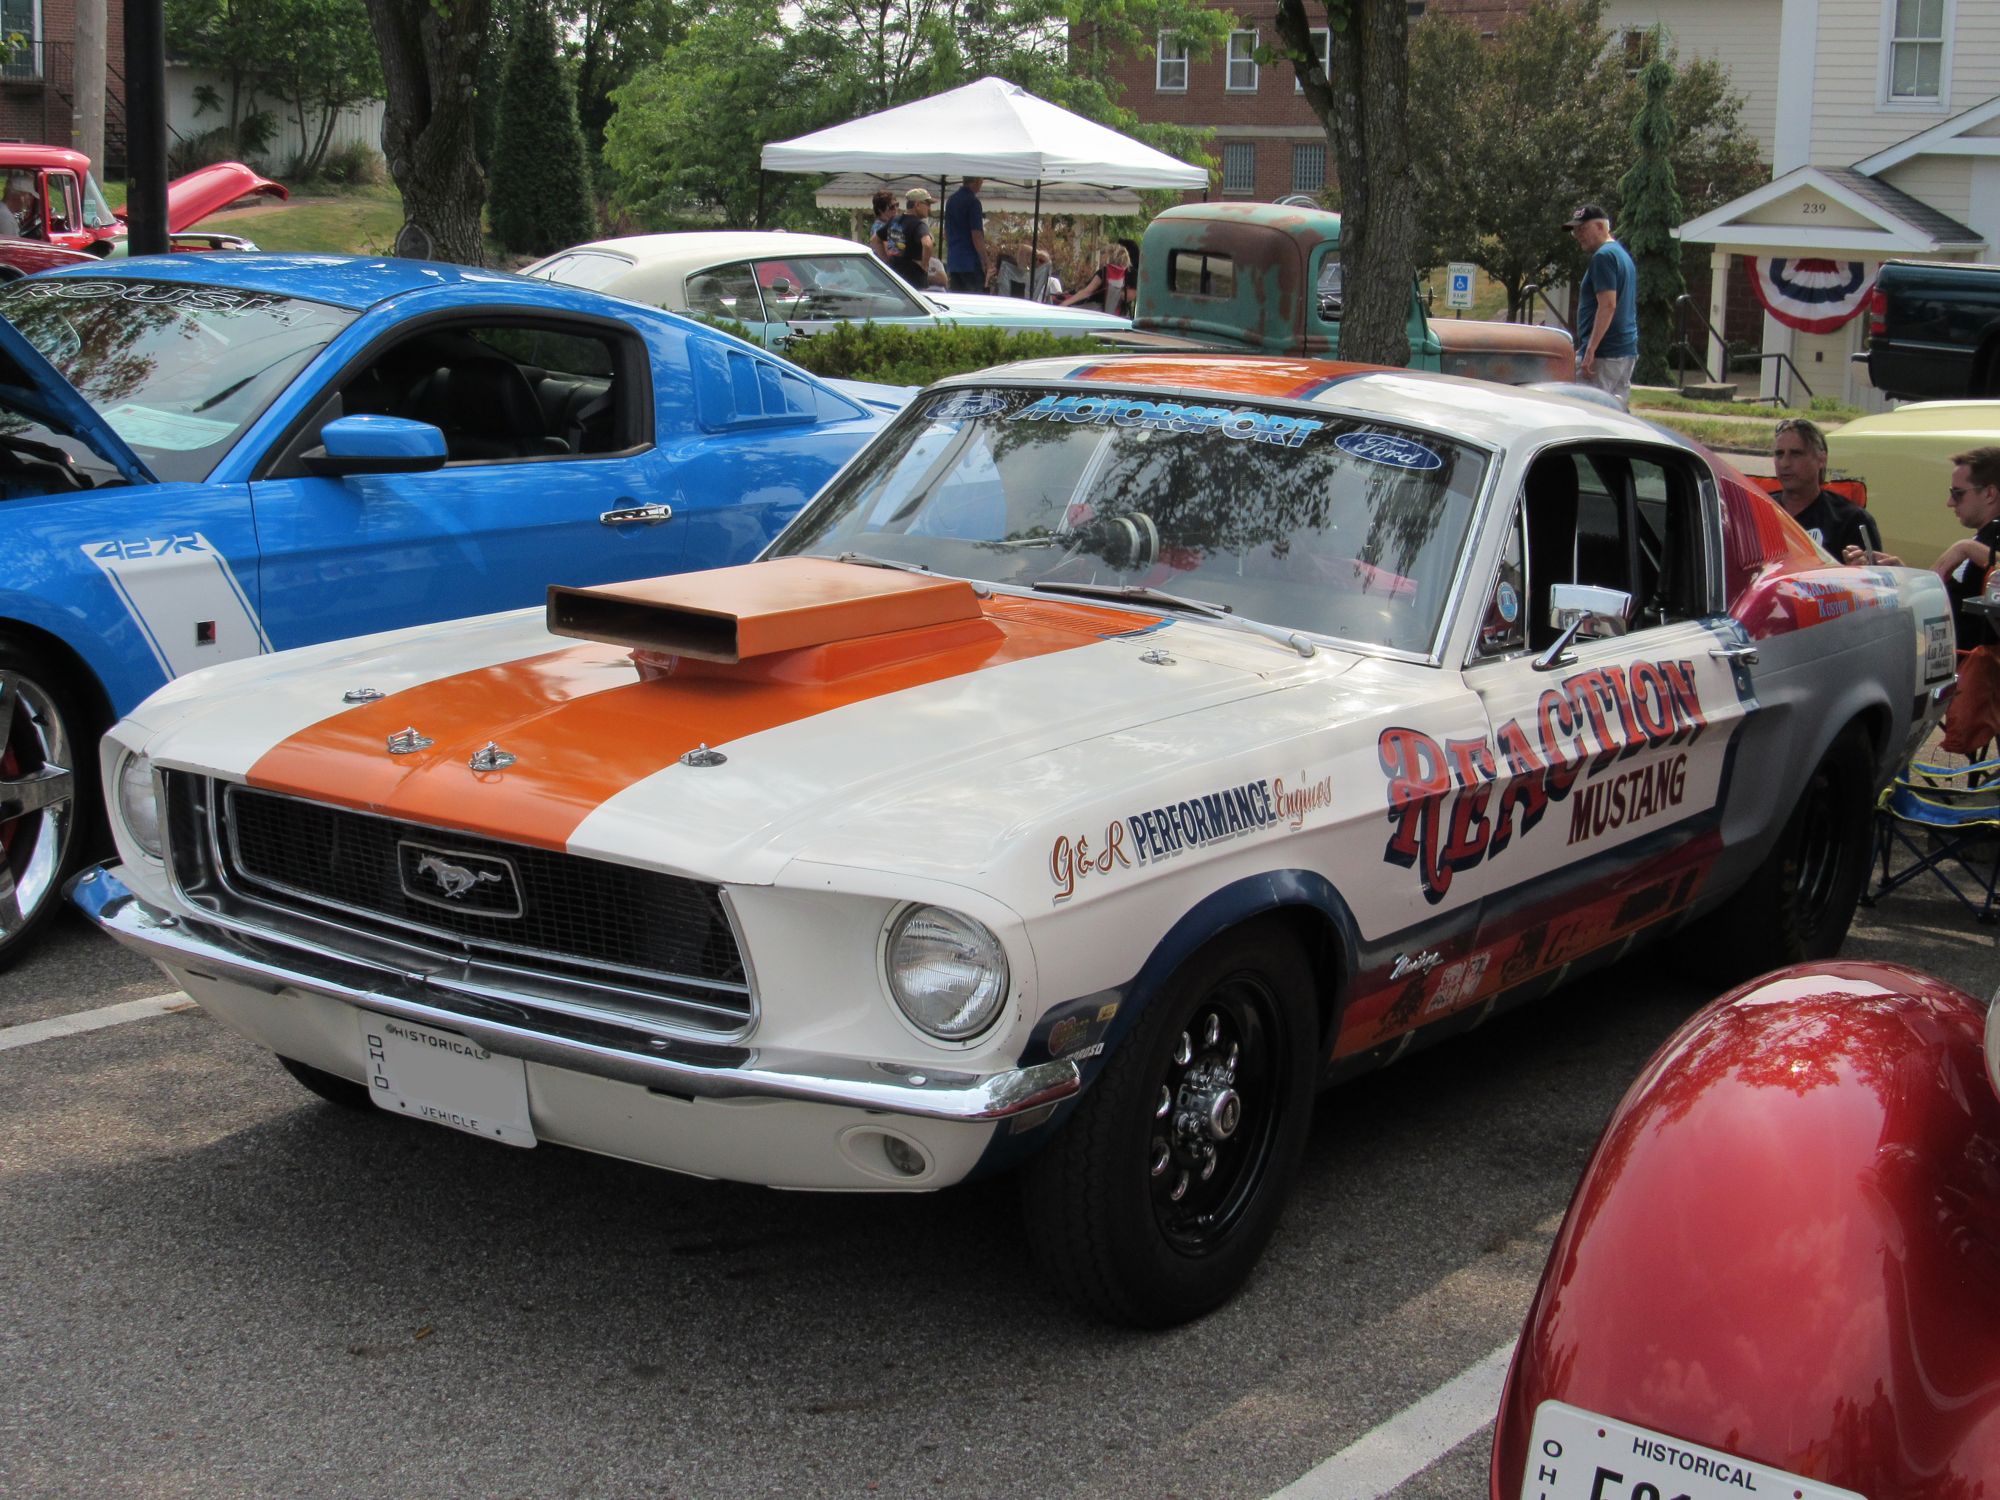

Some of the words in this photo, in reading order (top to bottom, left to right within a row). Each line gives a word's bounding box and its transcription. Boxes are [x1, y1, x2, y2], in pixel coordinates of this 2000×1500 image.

[1802, 203, 1826, 214] 239
[6, 282, 315, 327] ROUSH
[1006, 395, 1324, 448] MOTORSPORT
[1353, 436, 1423, 464] Ford
[94, 534, 209, 561] 427R
[1378, 659, 1707, 905] REACTION
[1566, 753, 1688, 846] MUSTANG
[1128, 779, 1277, 866] PERFORMANCE
[1273, 770, 1332, 831] Engines
[367, 1034, 390, 1090] OHIO
[393, 1028, 484, 1060] HISTORICAL
[420, 1105, 480, 1131] VEHICLE
[1632, 1436, 1757, 1491] HISTORICAL
